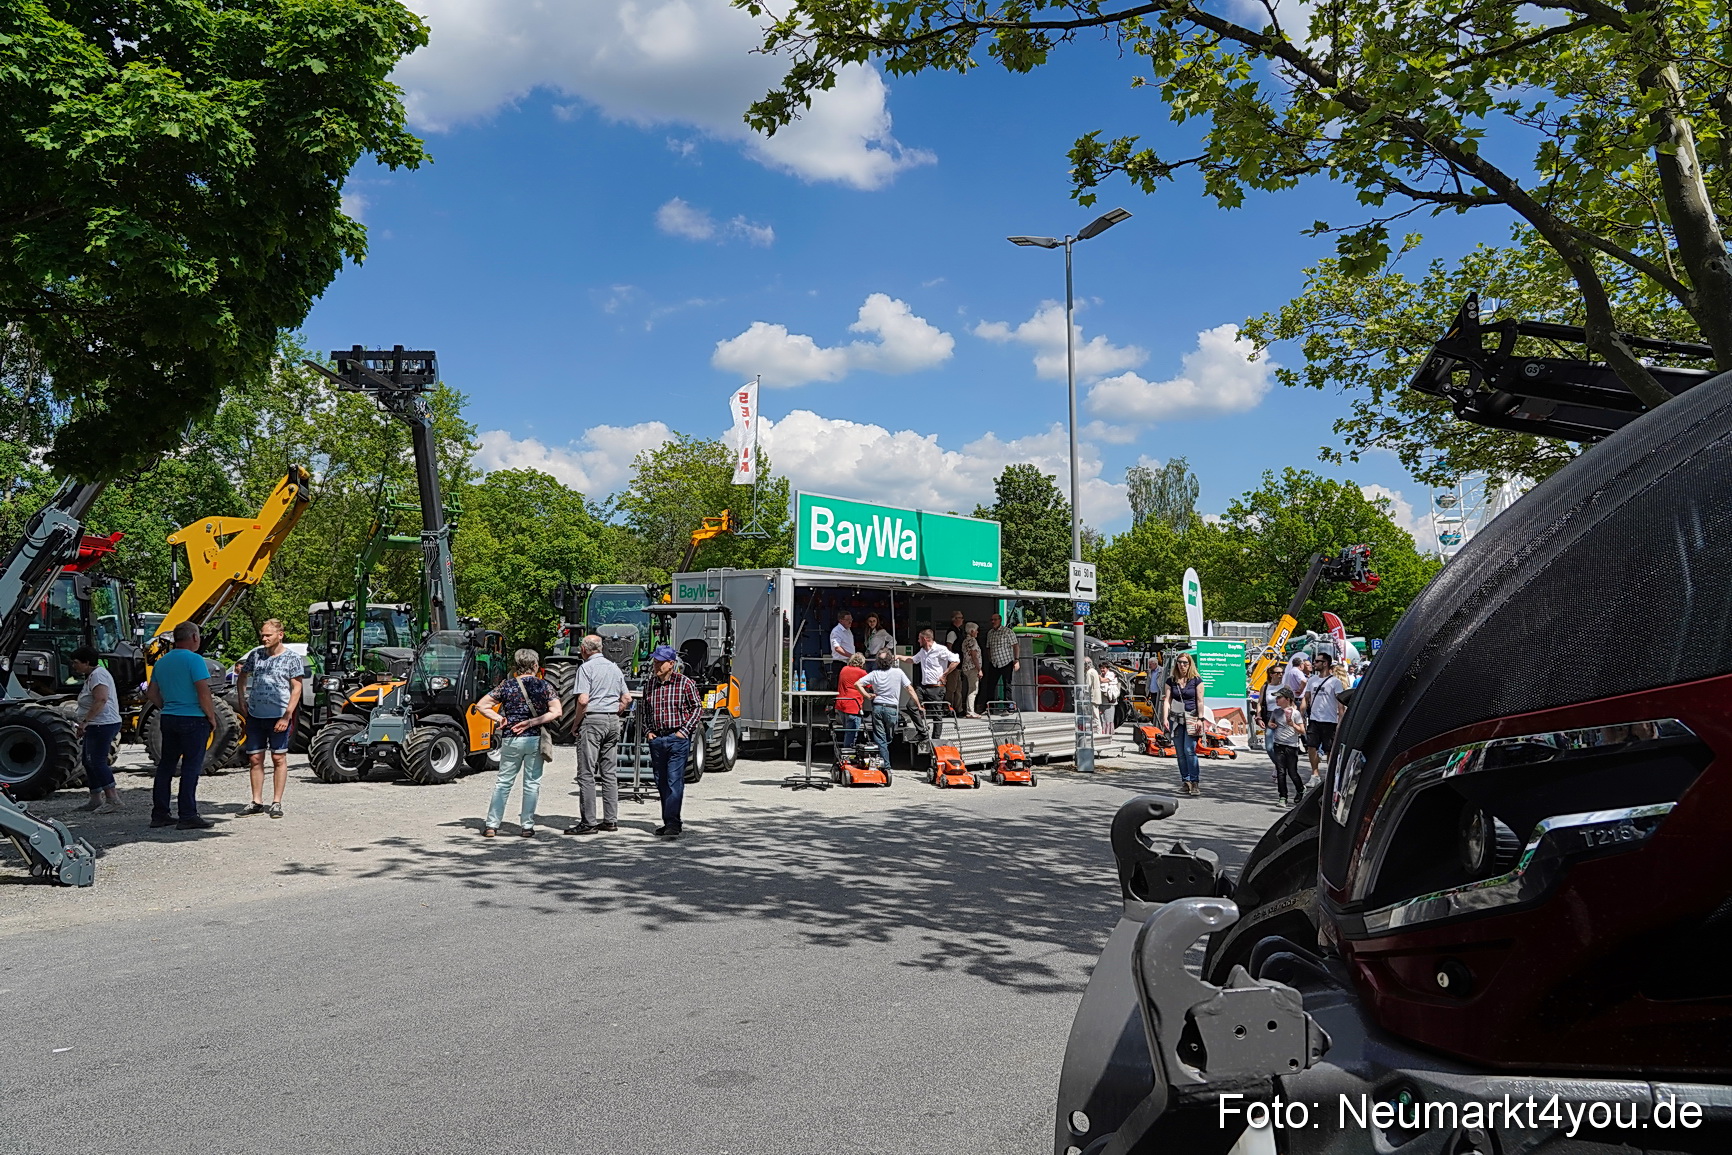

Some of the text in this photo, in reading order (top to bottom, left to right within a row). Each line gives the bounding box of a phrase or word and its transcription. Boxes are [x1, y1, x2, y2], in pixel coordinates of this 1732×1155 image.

[810, 505, 917, 565] BayWa
[972, 560, 993, 568] baywa.de
[1073, 567, 1081, 577] Taxi
[1084, 568, 1089, 578] 50
